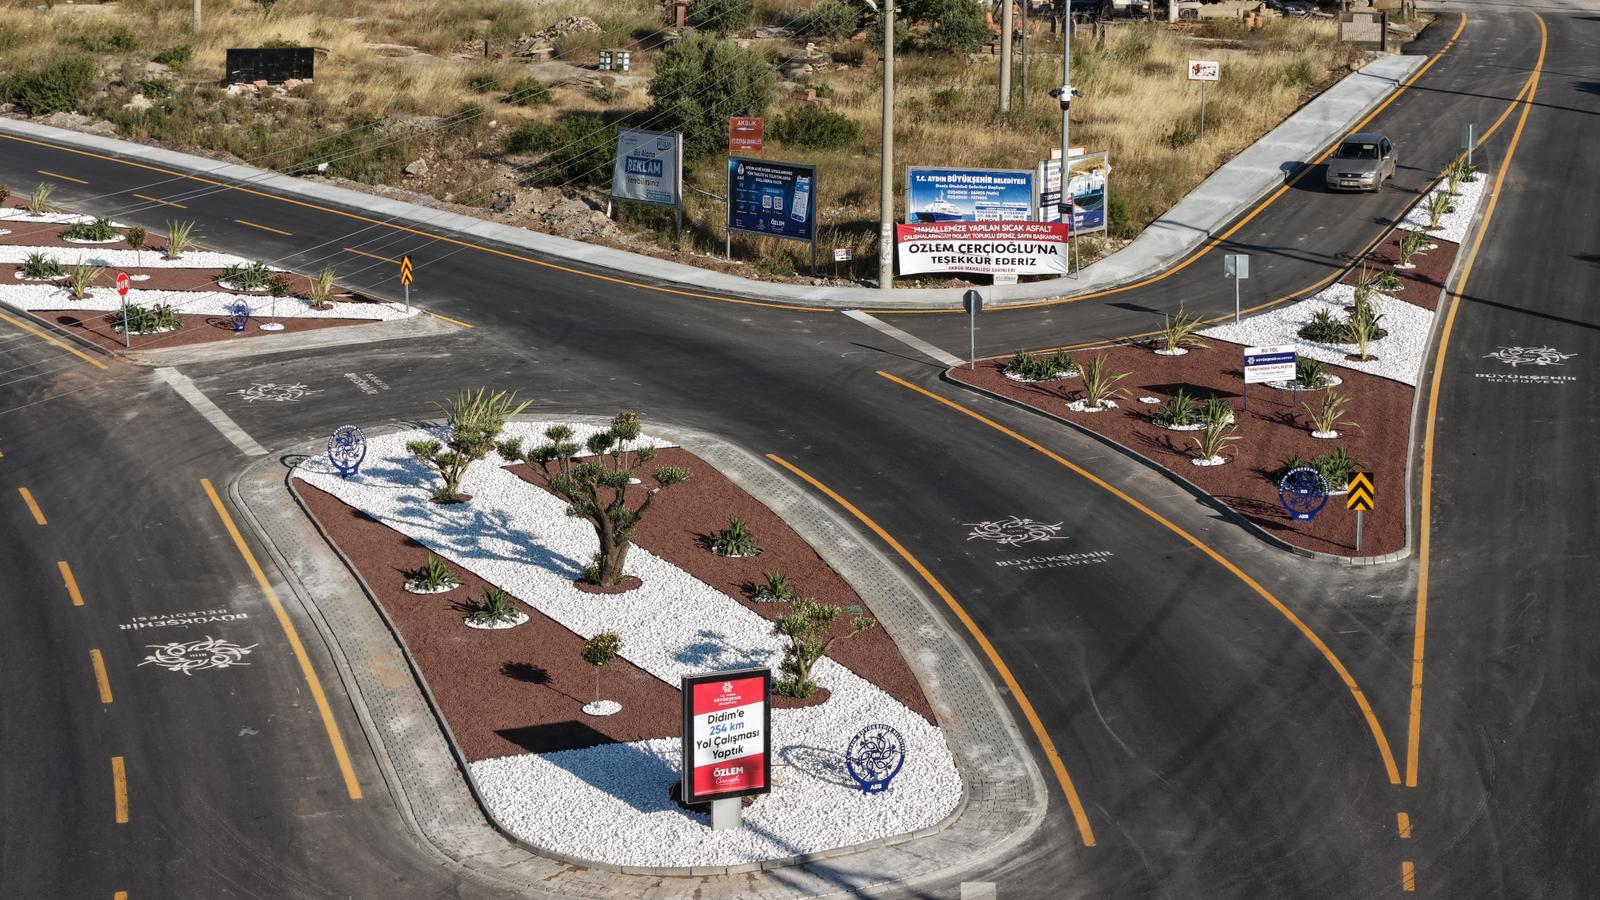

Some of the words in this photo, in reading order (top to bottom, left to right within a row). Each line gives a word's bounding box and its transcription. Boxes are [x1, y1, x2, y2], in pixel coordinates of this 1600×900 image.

[628, 158, 662, 174] REKLAM
[947, 174, 992, 186] BÜYÜKŞEHİR
[993, 177, 1026, 185] BELEDİYESİ
[914, 224, 966, 232] MAHALLEMİZE
[909, 242, 954, 254] ÖZLEM
[958, 242, 1058, 256] ÇERÇİOĞLU'NA
[995, 257, 1037, 266] EDERİZ
[116, 279, 128, 290] DUR
[708, 710, 744, 724] Didim'e
[710, 724, 727, 736] 254
[730, 721, 744, 732] km
[696, 738, 712, 750] Yol
[714, 730, 760, 748] Çalışması
[712, 744, 744, 760] Yaptık
[714, 766, 744, 778] ÖZLEM
